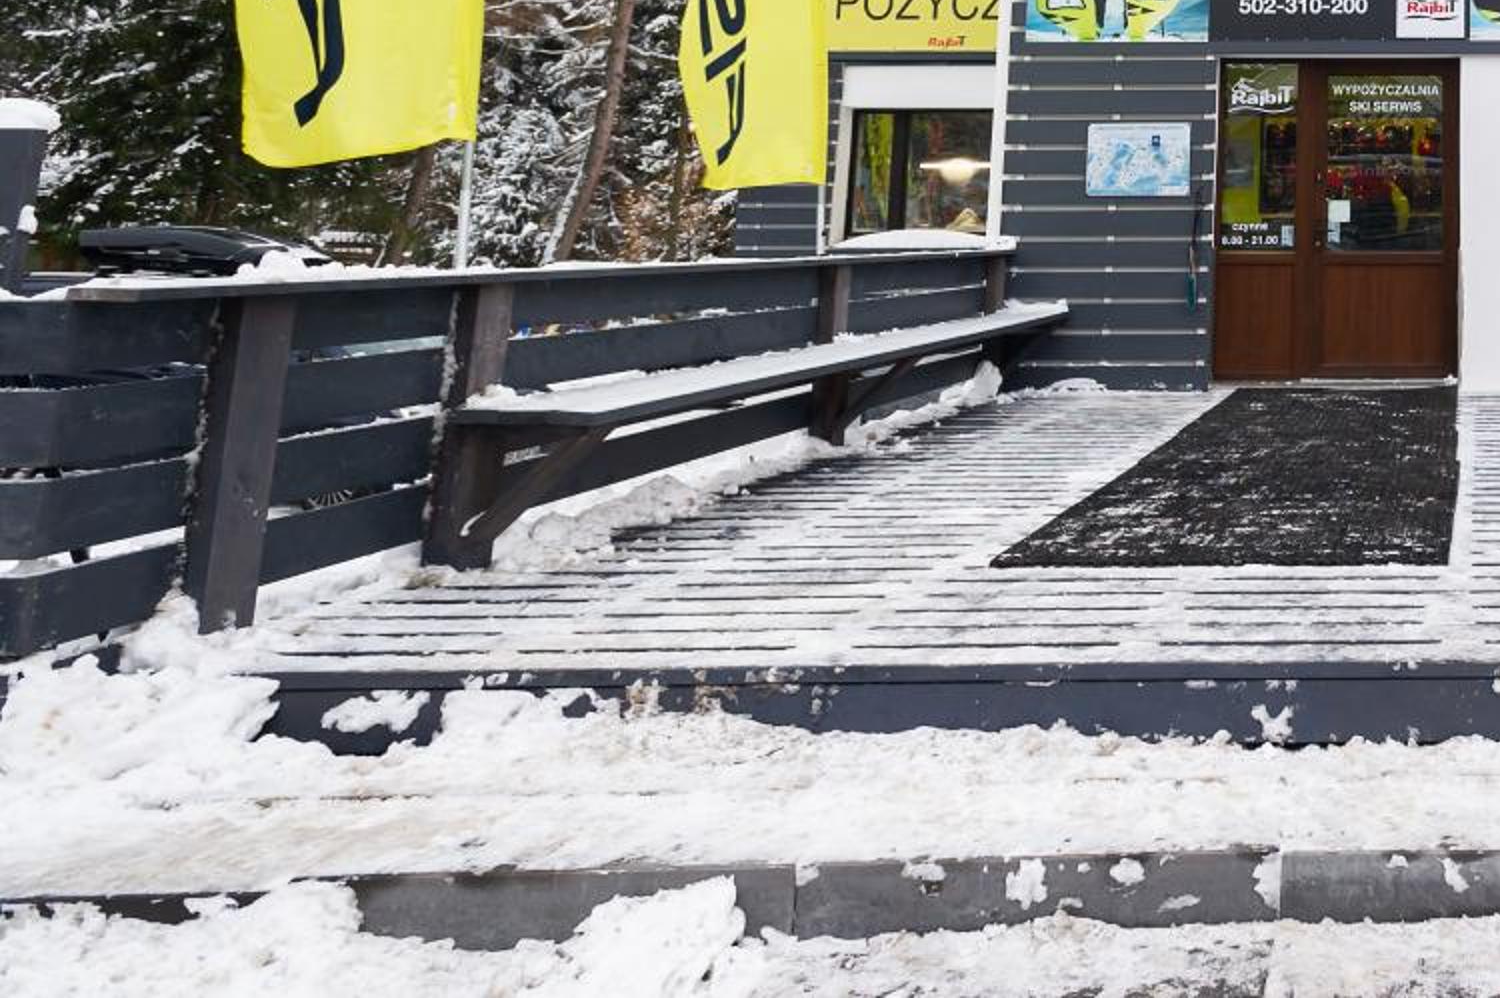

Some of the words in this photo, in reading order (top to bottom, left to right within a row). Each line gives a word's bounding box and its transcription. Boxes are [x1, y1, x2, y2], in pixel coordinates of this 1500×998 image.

[1331, 82, 1440, 96] WYPOŻYCZALNIA
[1349, 101, 1371, 113] SKI
[1373, 101, 1423, 113] SERWIS
